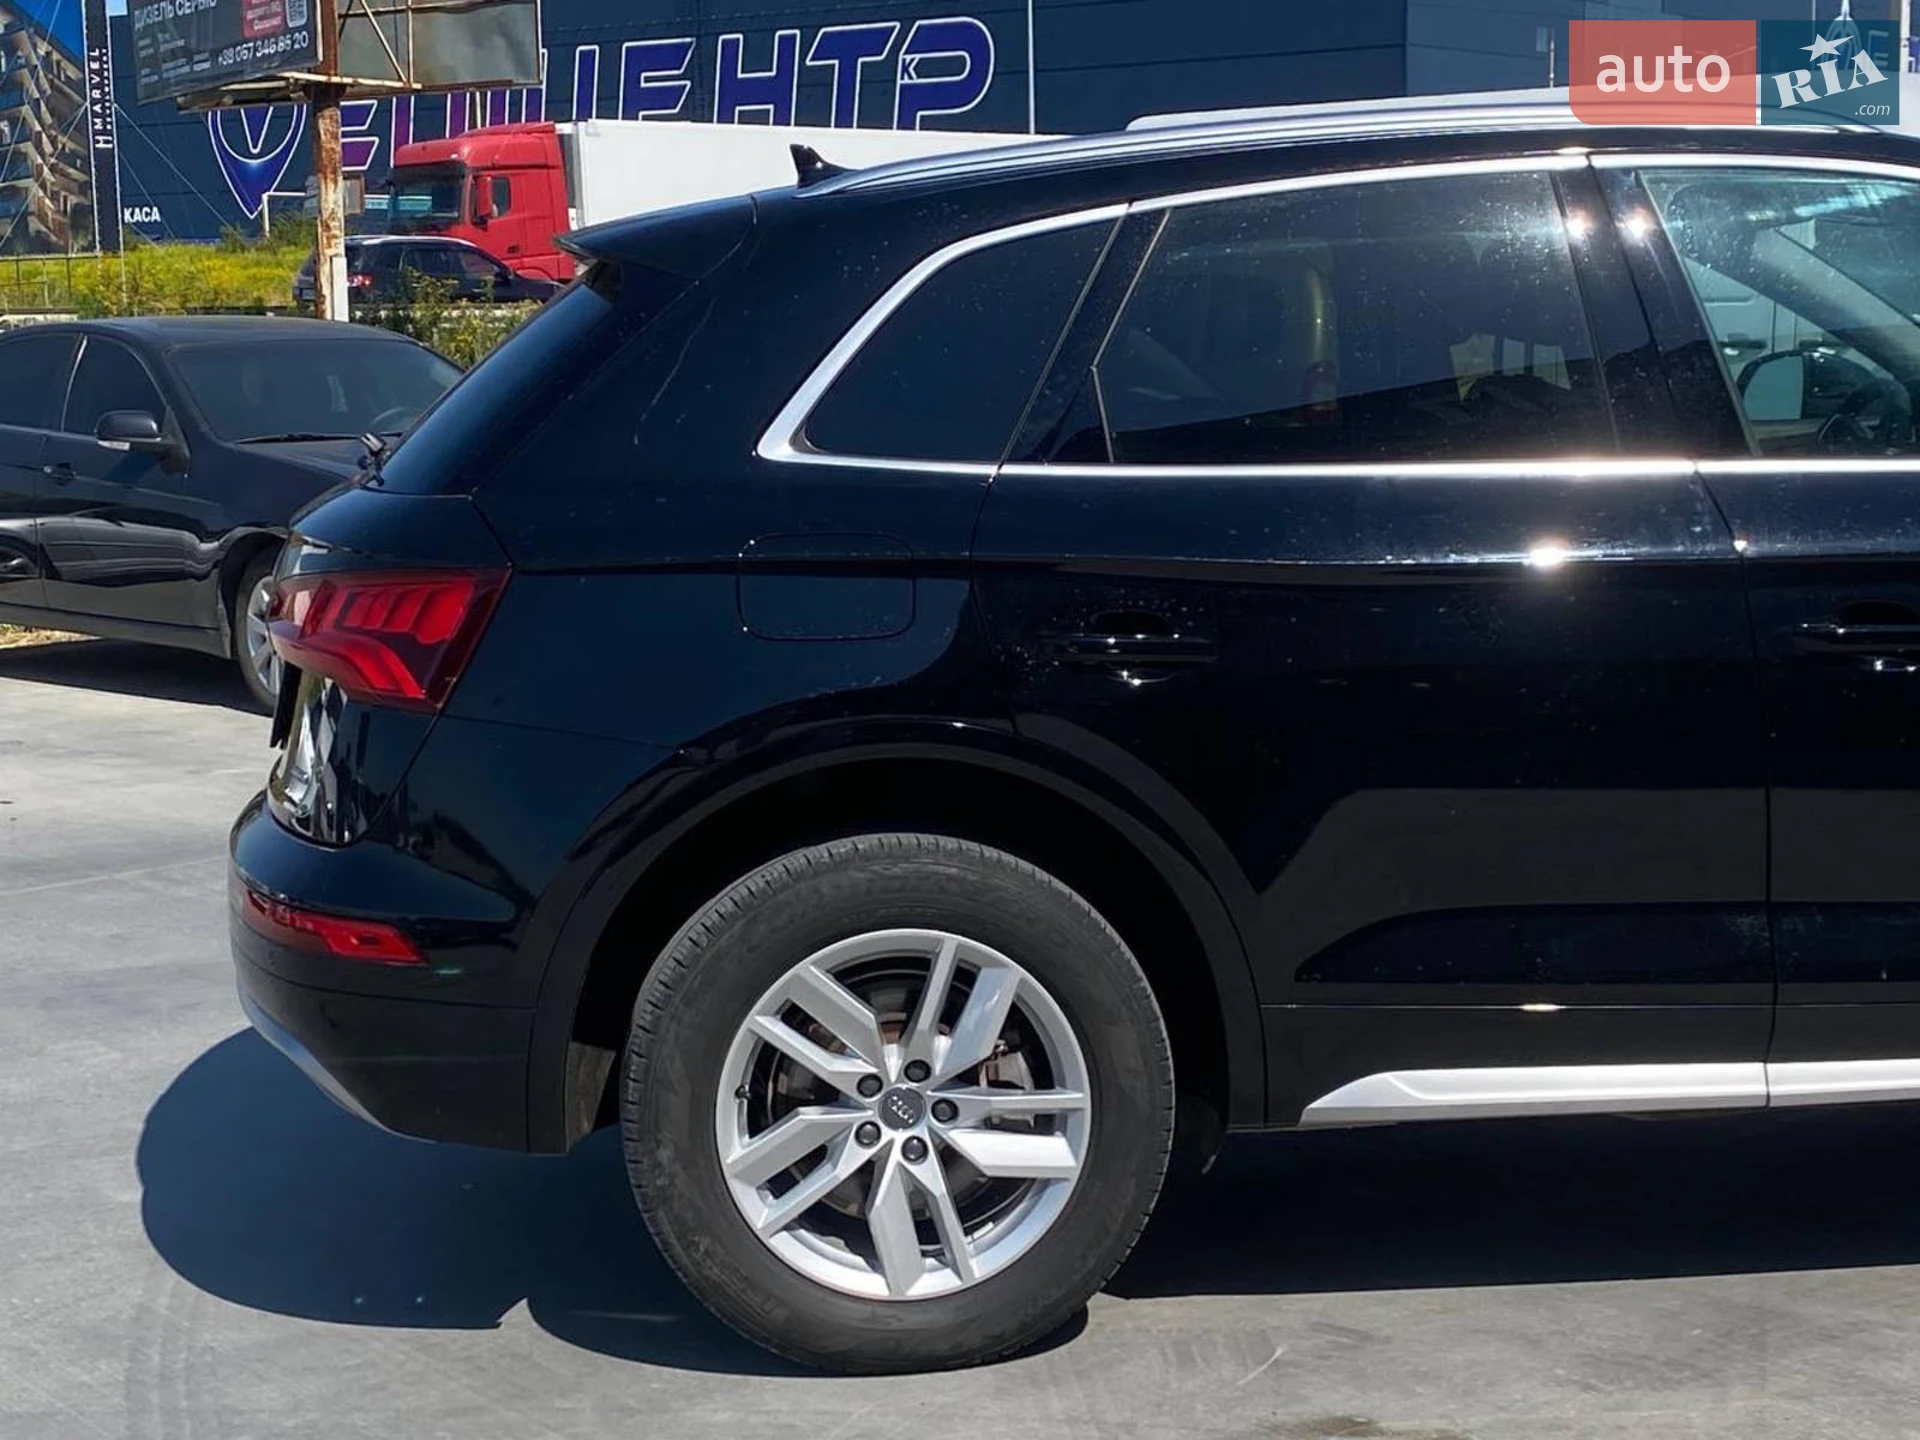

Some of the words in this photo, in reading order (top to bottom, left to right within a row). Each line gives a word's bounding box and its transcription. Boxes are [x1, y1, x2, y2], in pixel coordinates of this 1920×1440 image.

[235, 42, 254, 61] 067
[293, 30, 309, 49] 20
[89, 48, 103, 130] MARVEL
[123, 207, 161, 223] КАСА
